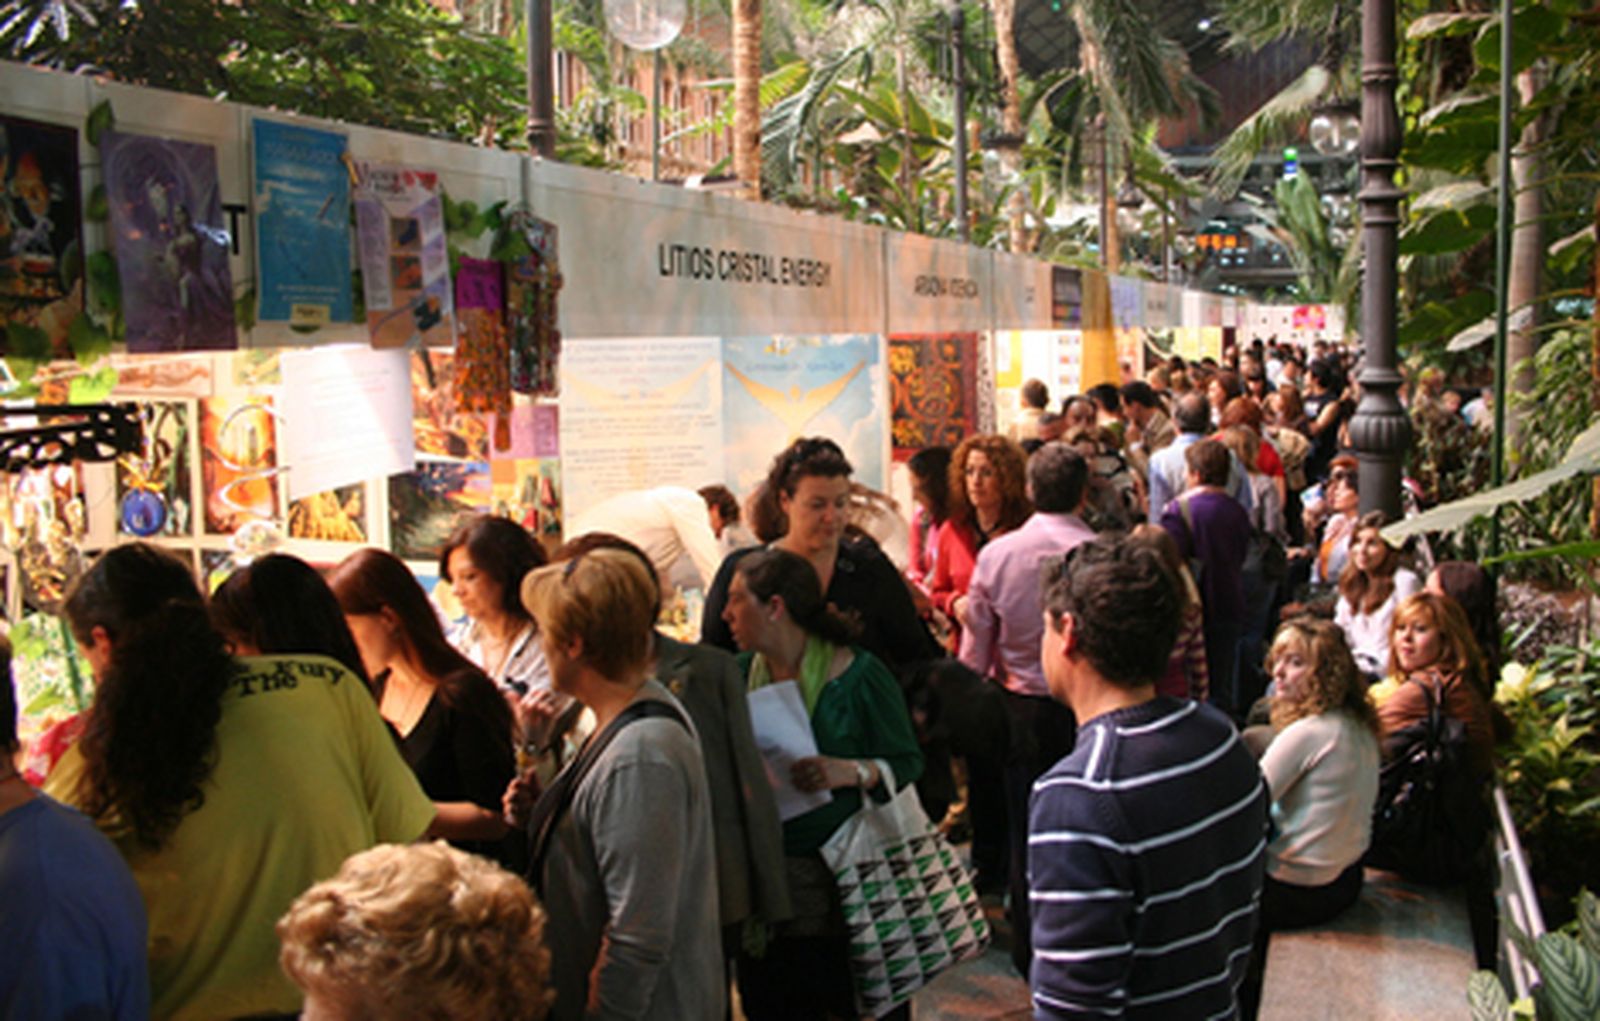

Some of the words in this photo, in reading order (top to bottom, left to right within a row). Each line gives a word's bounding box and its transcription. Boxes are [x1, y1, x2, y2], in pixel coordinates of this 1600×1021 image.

[658, 244, 714, 280] LITIOS
[717, 250, 777, 285] CRISTAL
[780, 257, 831, 288] ENERGY
[233, 671, 298, 696] The
